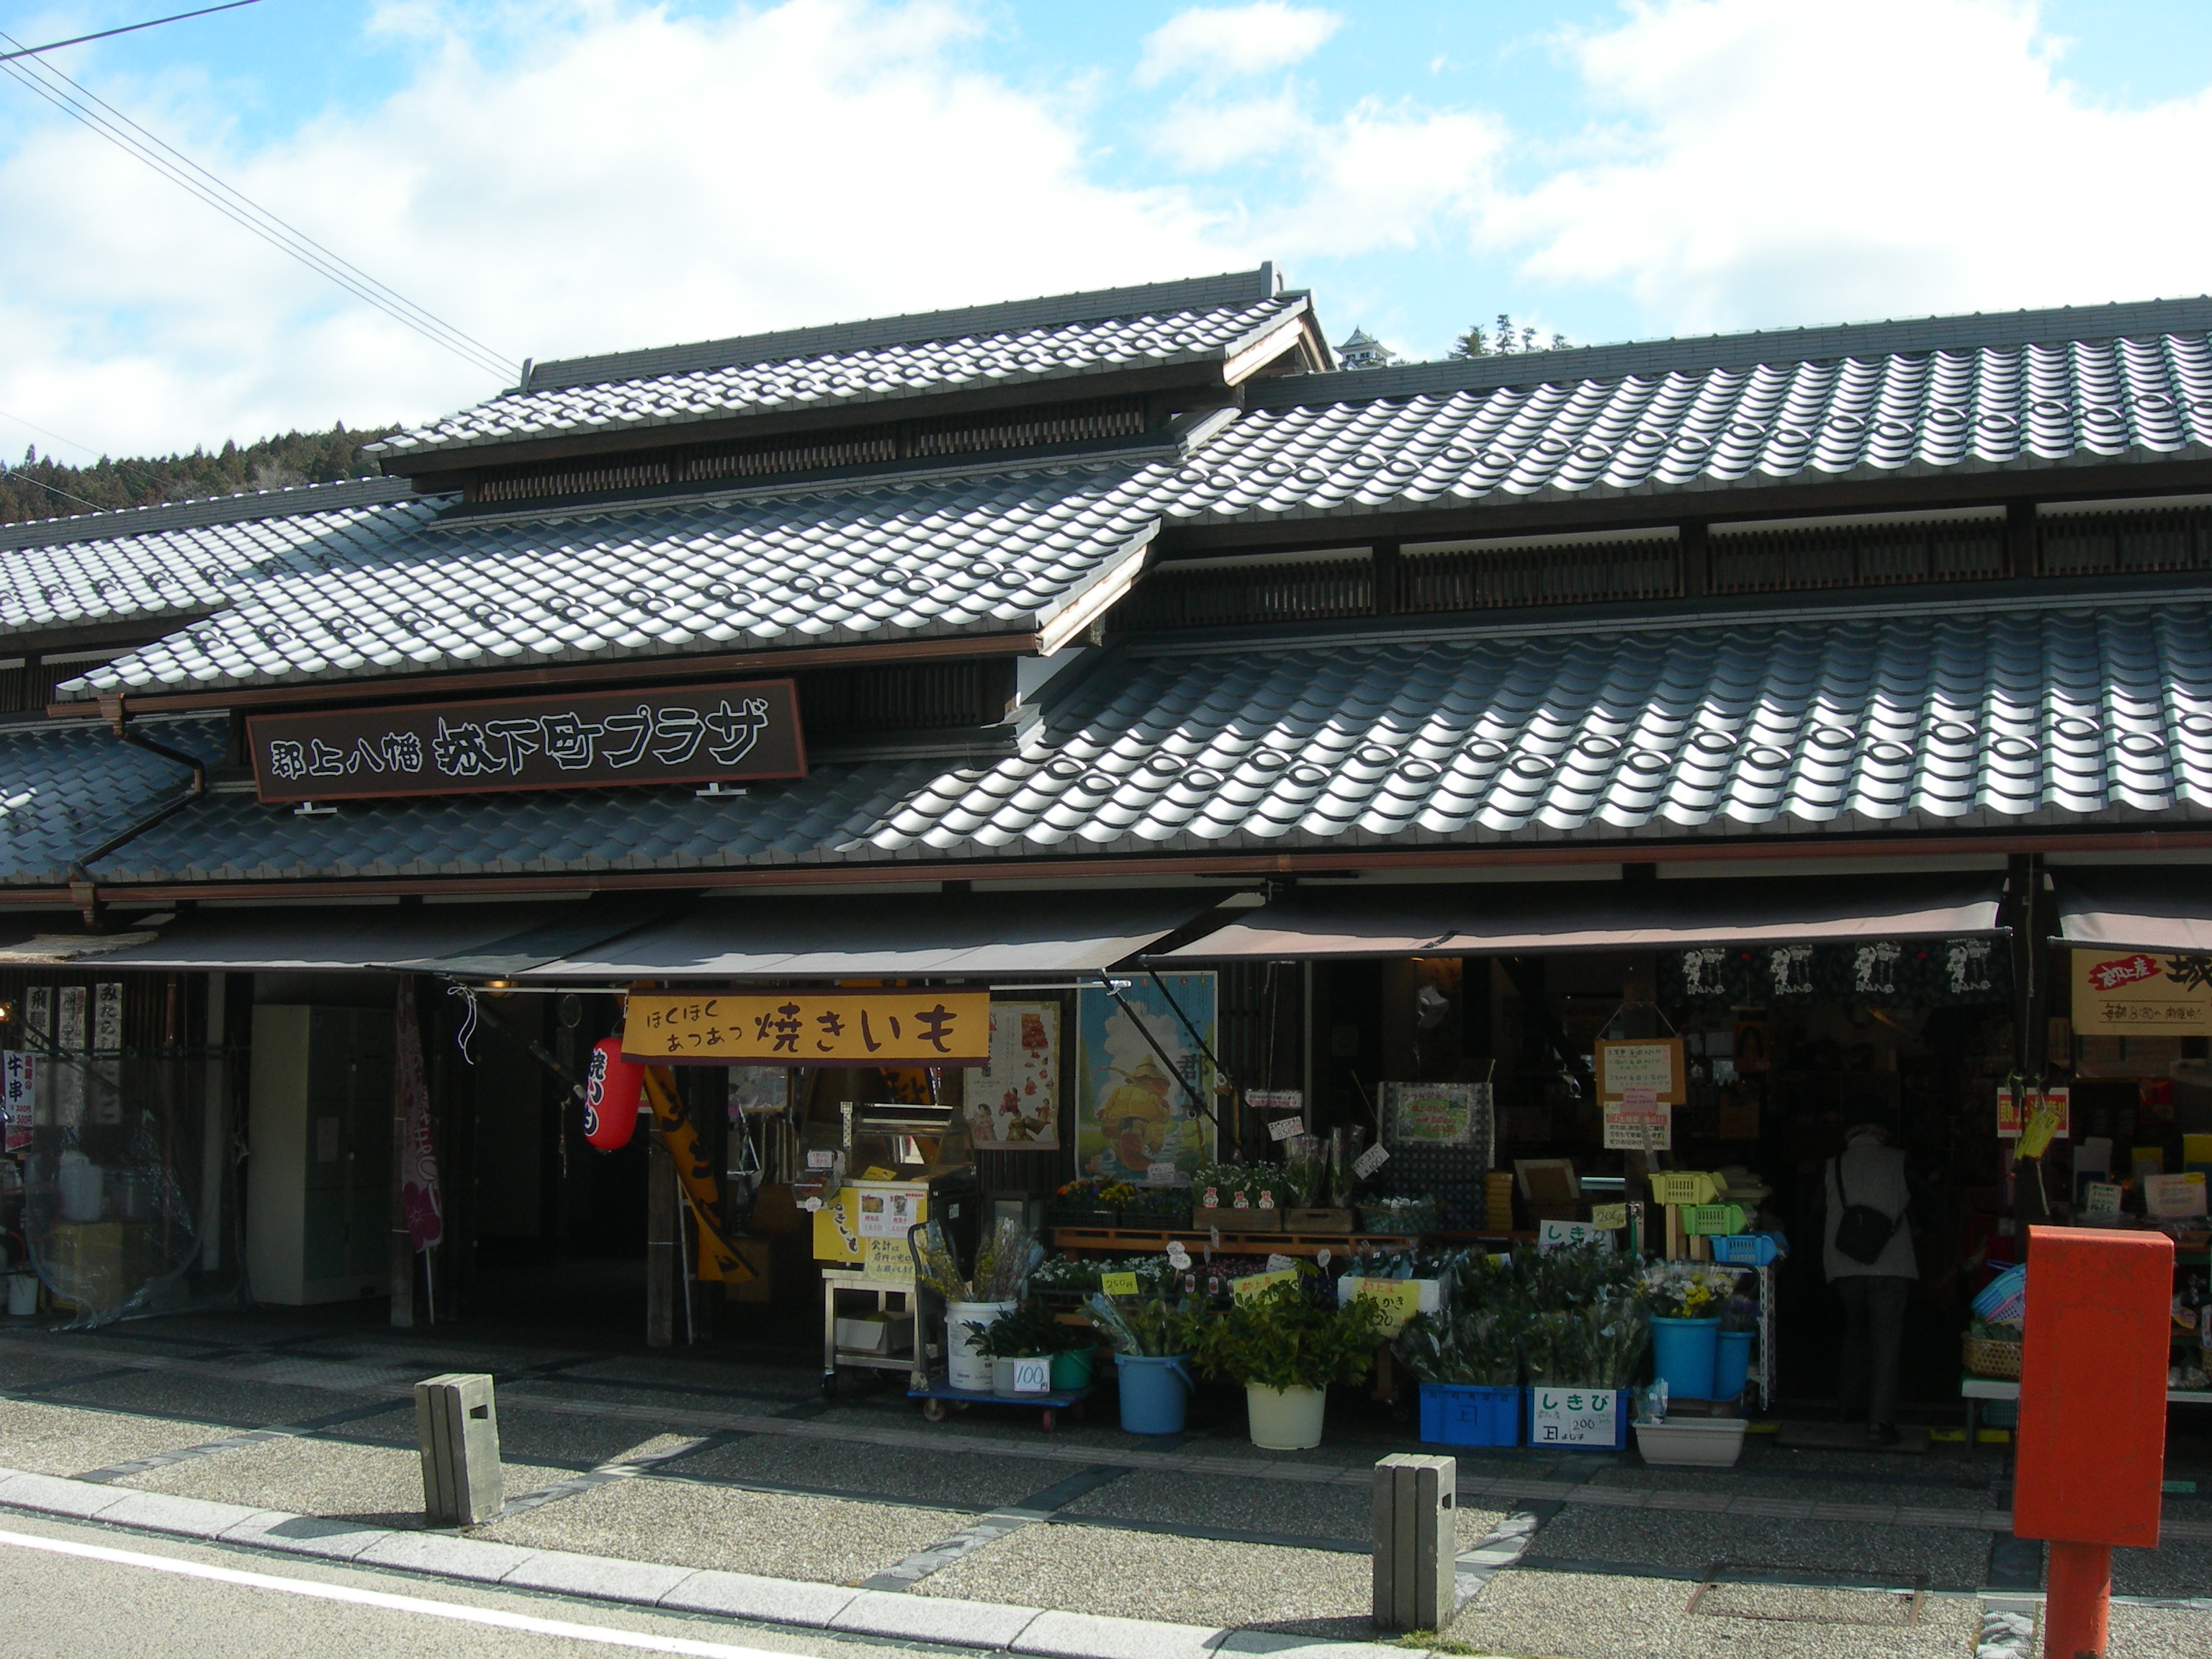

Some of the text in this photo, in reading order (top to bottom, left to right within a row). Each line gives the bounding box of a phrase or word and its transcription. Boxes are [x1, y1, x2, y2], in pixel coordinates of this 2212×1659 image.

[647, 999, 719, 1029] ほくほく
[755, 1002, 957, 1053] 焼きいも
[667, 1027, 742, 1052] あつあつ
[8, 1054, 23, 1102] 牛串
[1106, 1280, 1133, 1289] 250円
[1543, 1393, 1610, 1411] しきび
